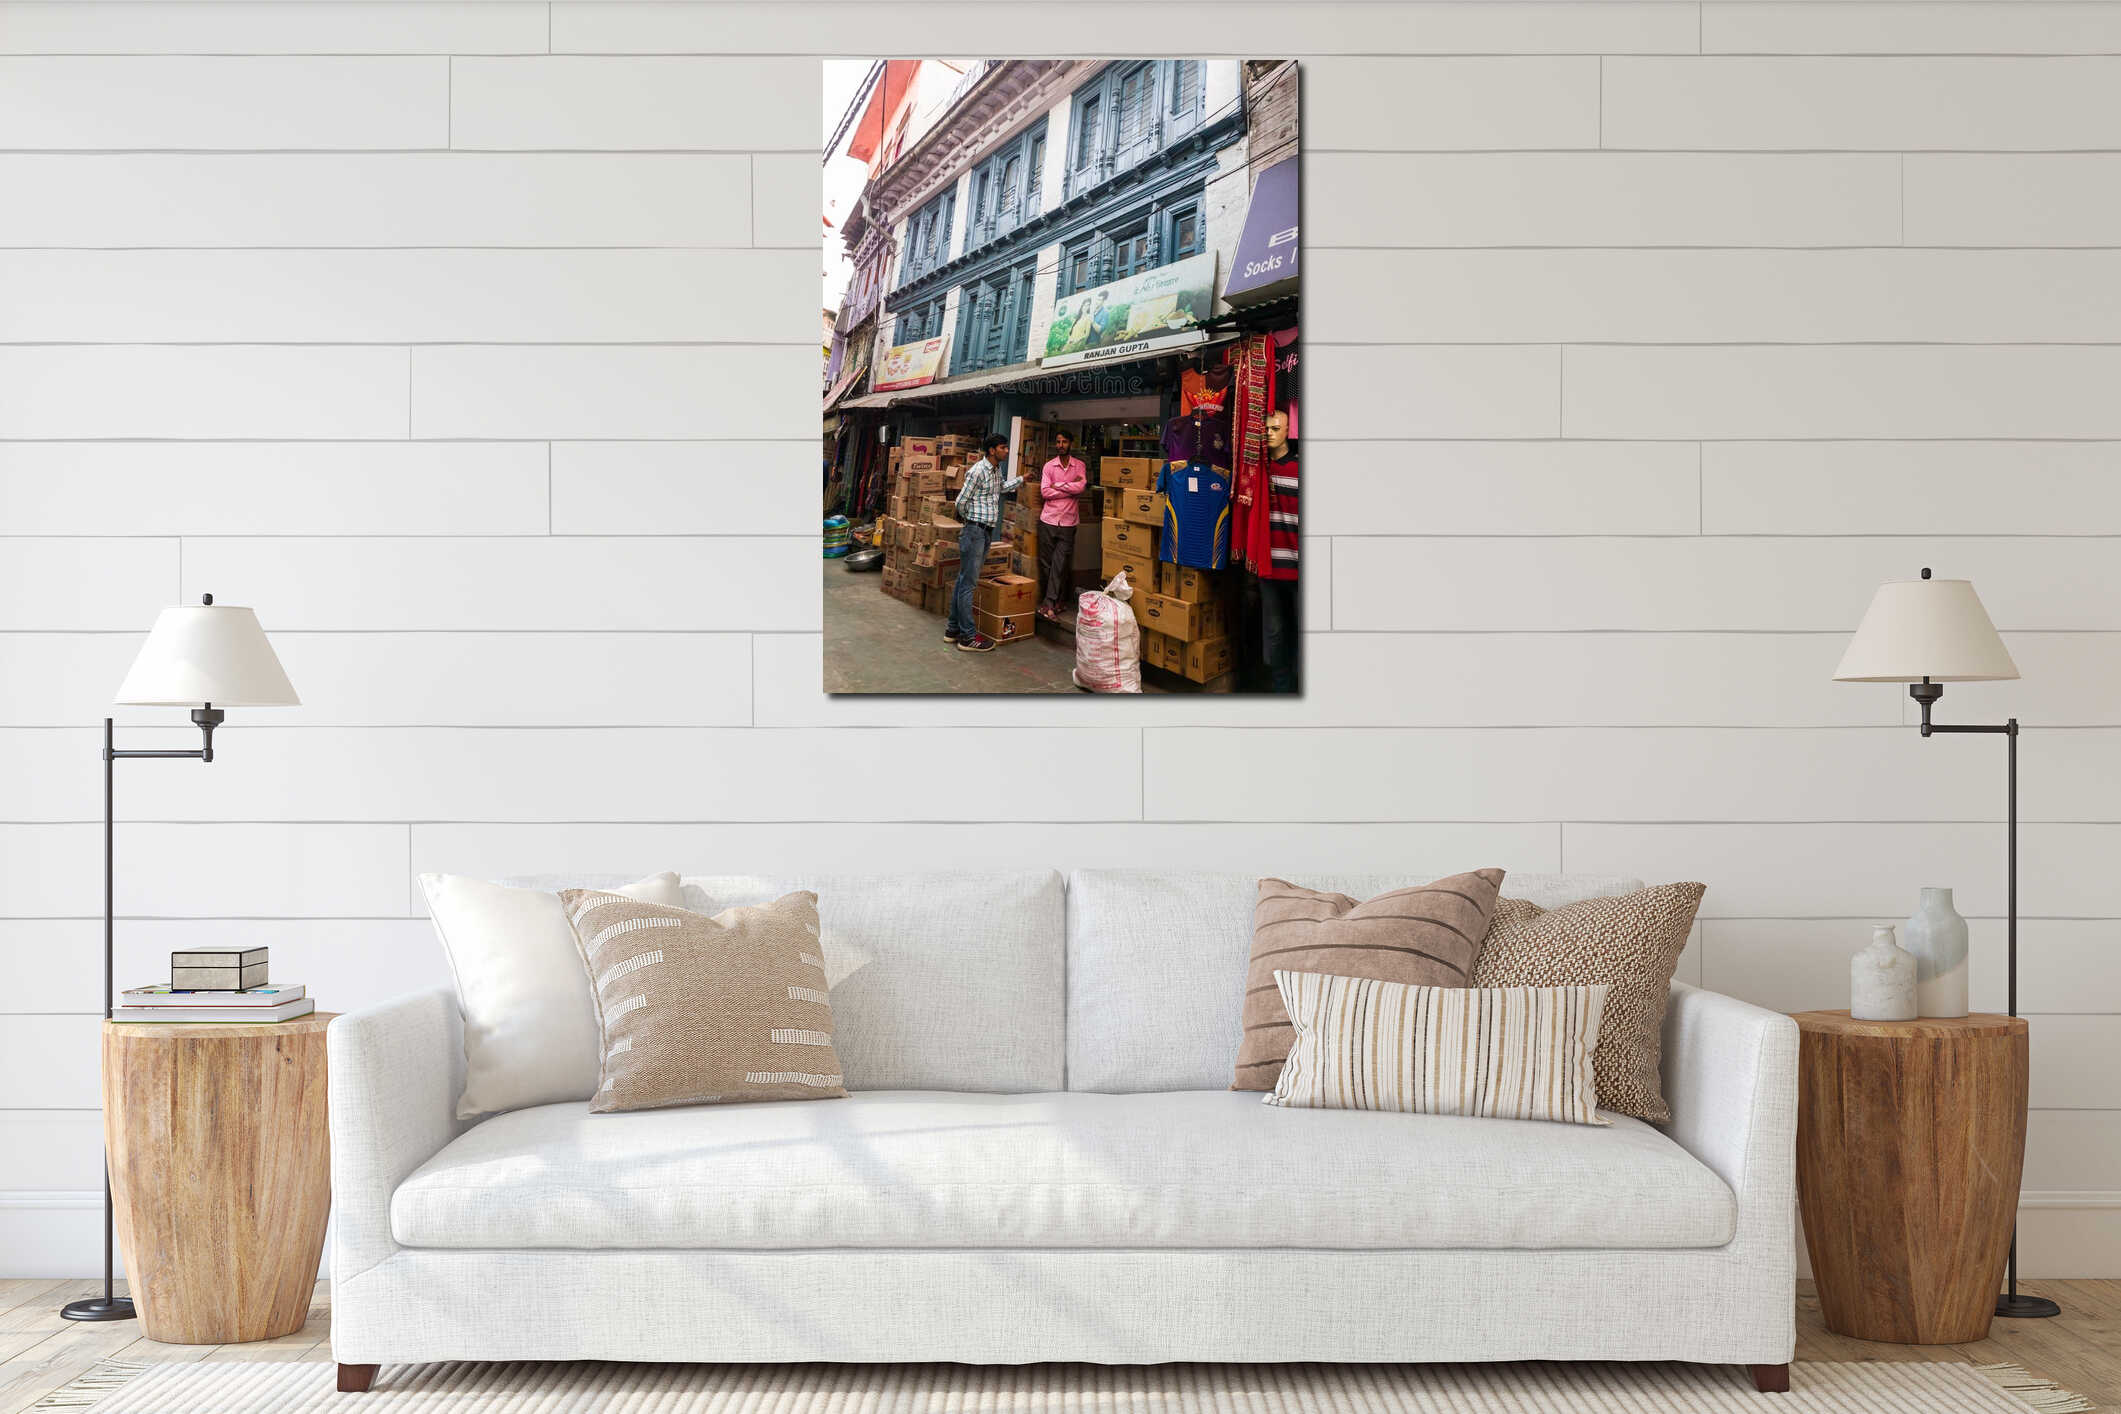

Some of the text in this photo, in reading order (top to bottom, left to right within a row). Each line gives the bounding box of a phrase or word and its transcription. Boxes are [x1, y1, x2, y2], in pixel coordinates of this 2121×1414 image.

[1243, 255, 1283, 279] Socks
[1084, 342, 1149, 360] RANJAN GUPTA
